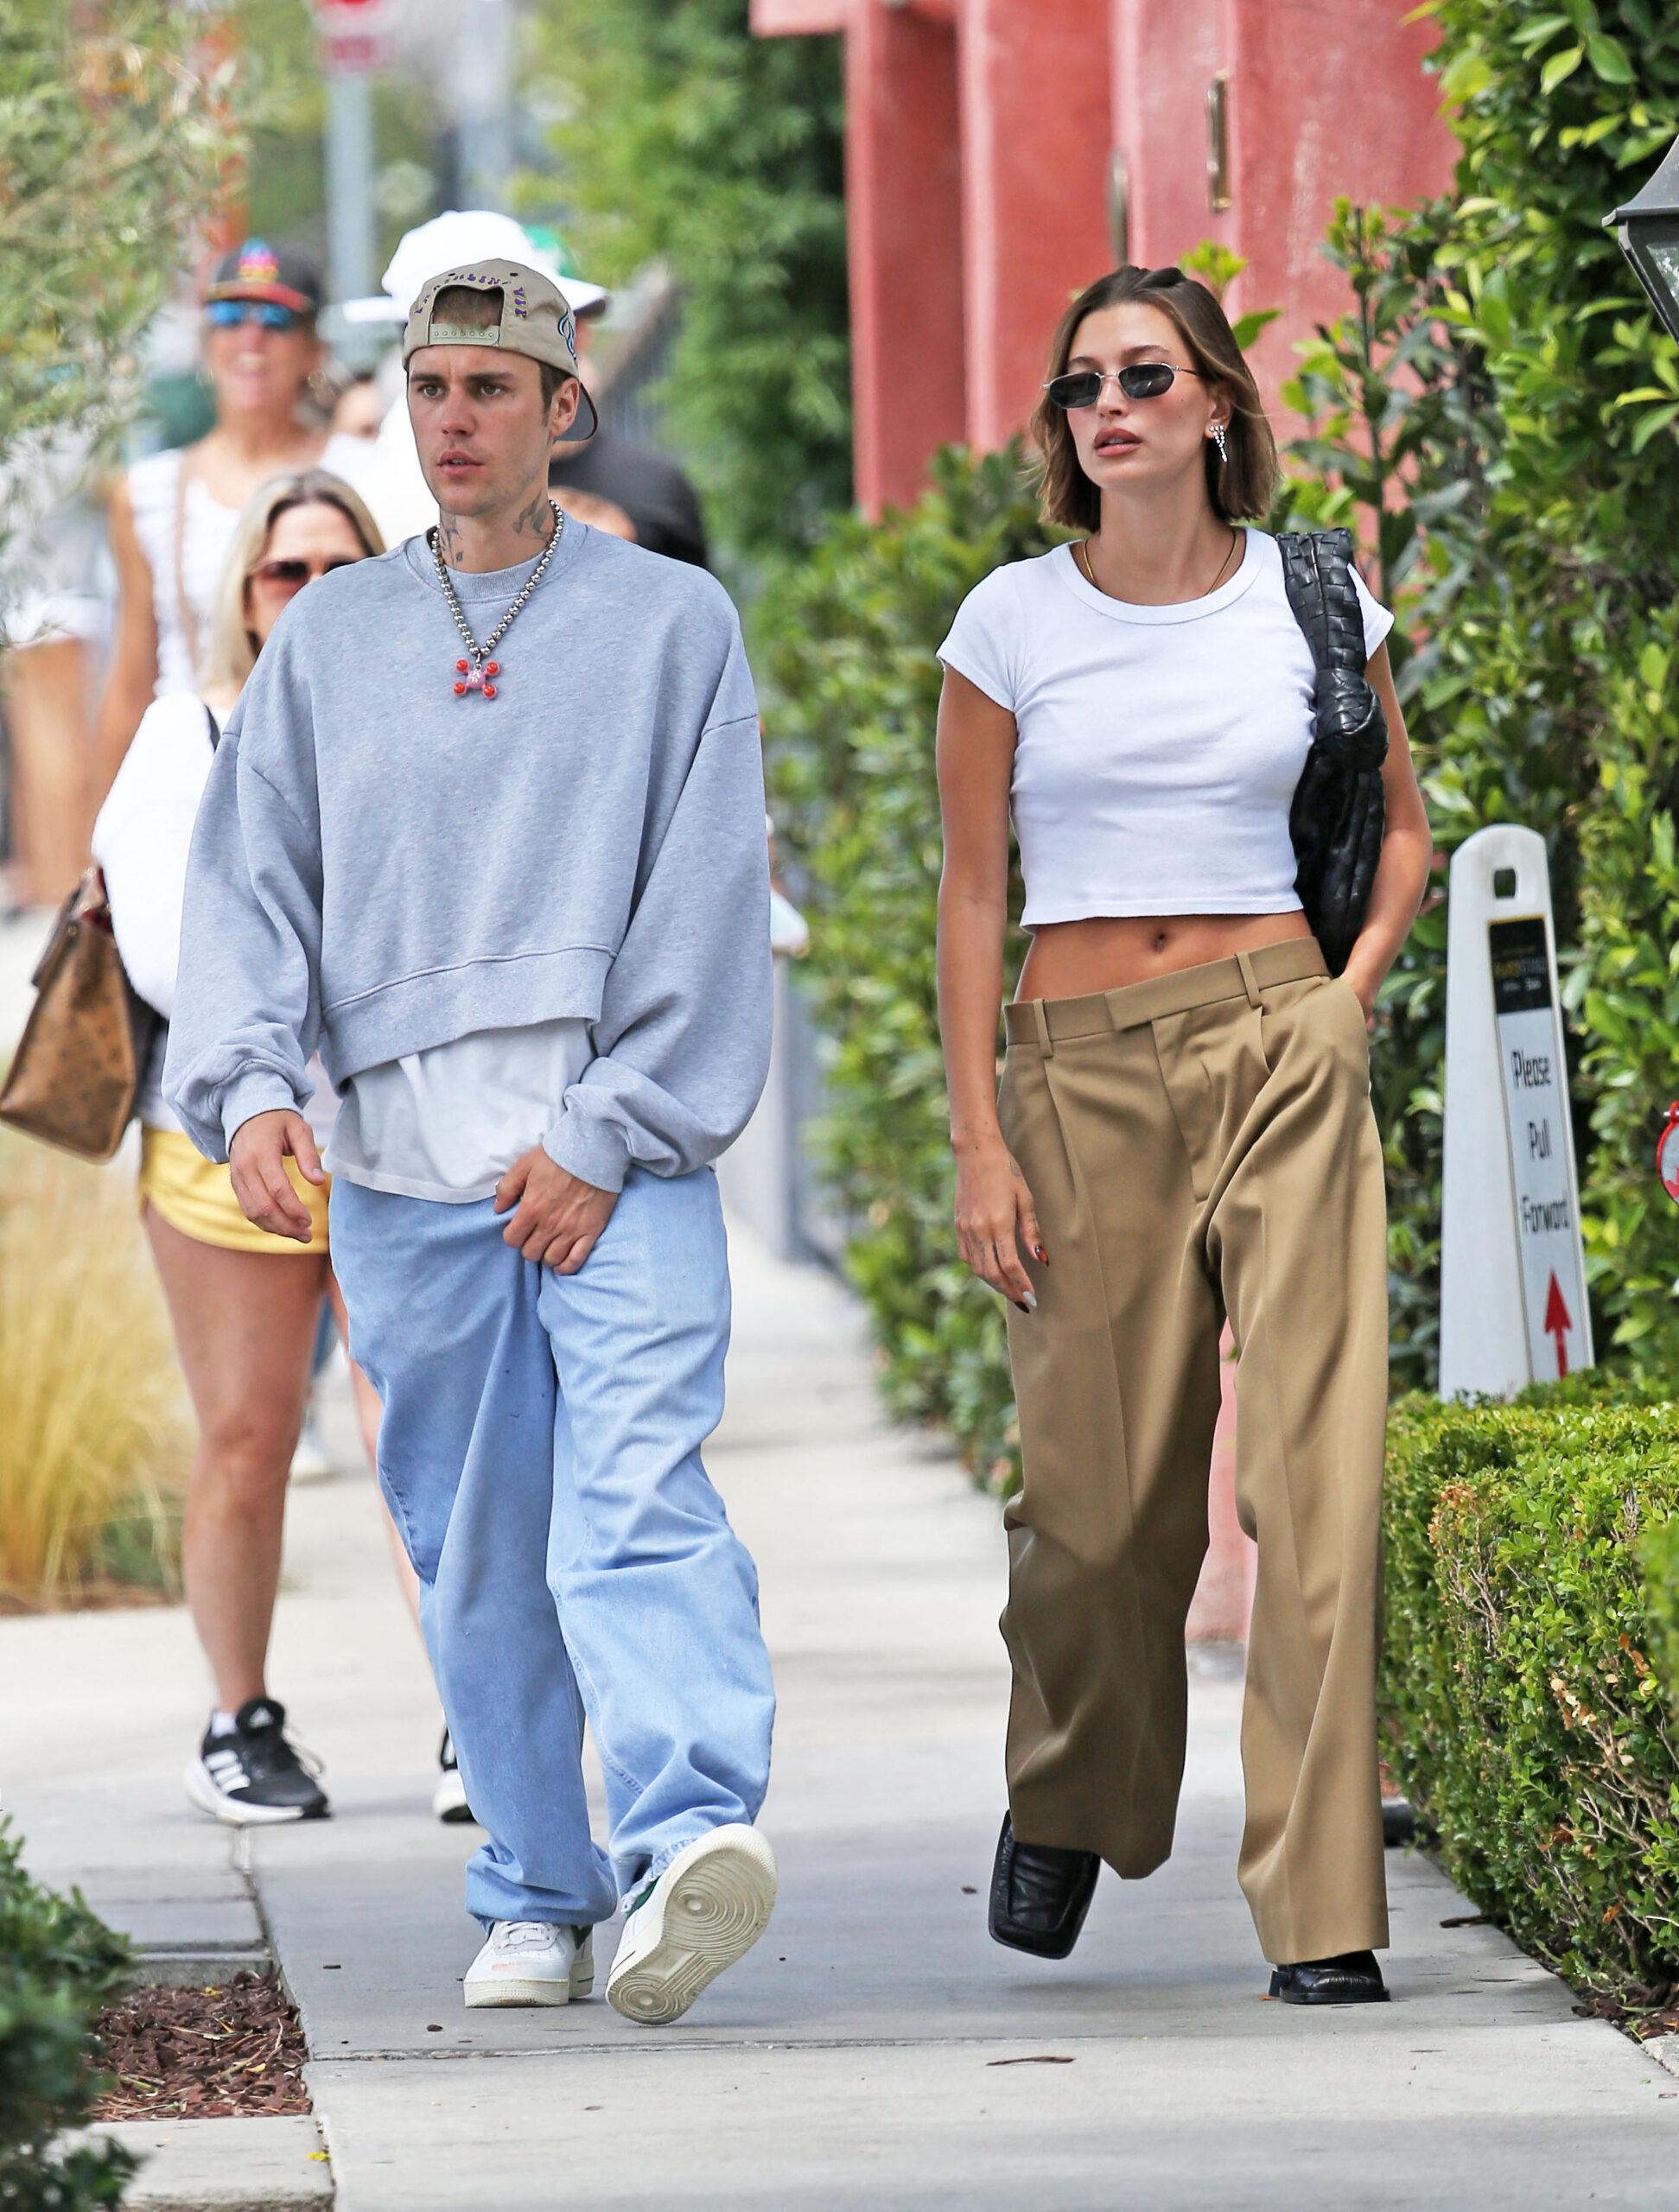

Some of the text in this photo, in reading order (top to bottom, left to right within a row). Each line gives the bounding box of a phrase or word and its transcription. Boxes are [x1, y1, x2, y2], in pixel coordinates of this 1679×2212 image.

[1512, 1050, 1551, 1089] Please
[1528, 1118, 1552, 1159] Pull
[1521, 1192, 1570, 1233] Forward
